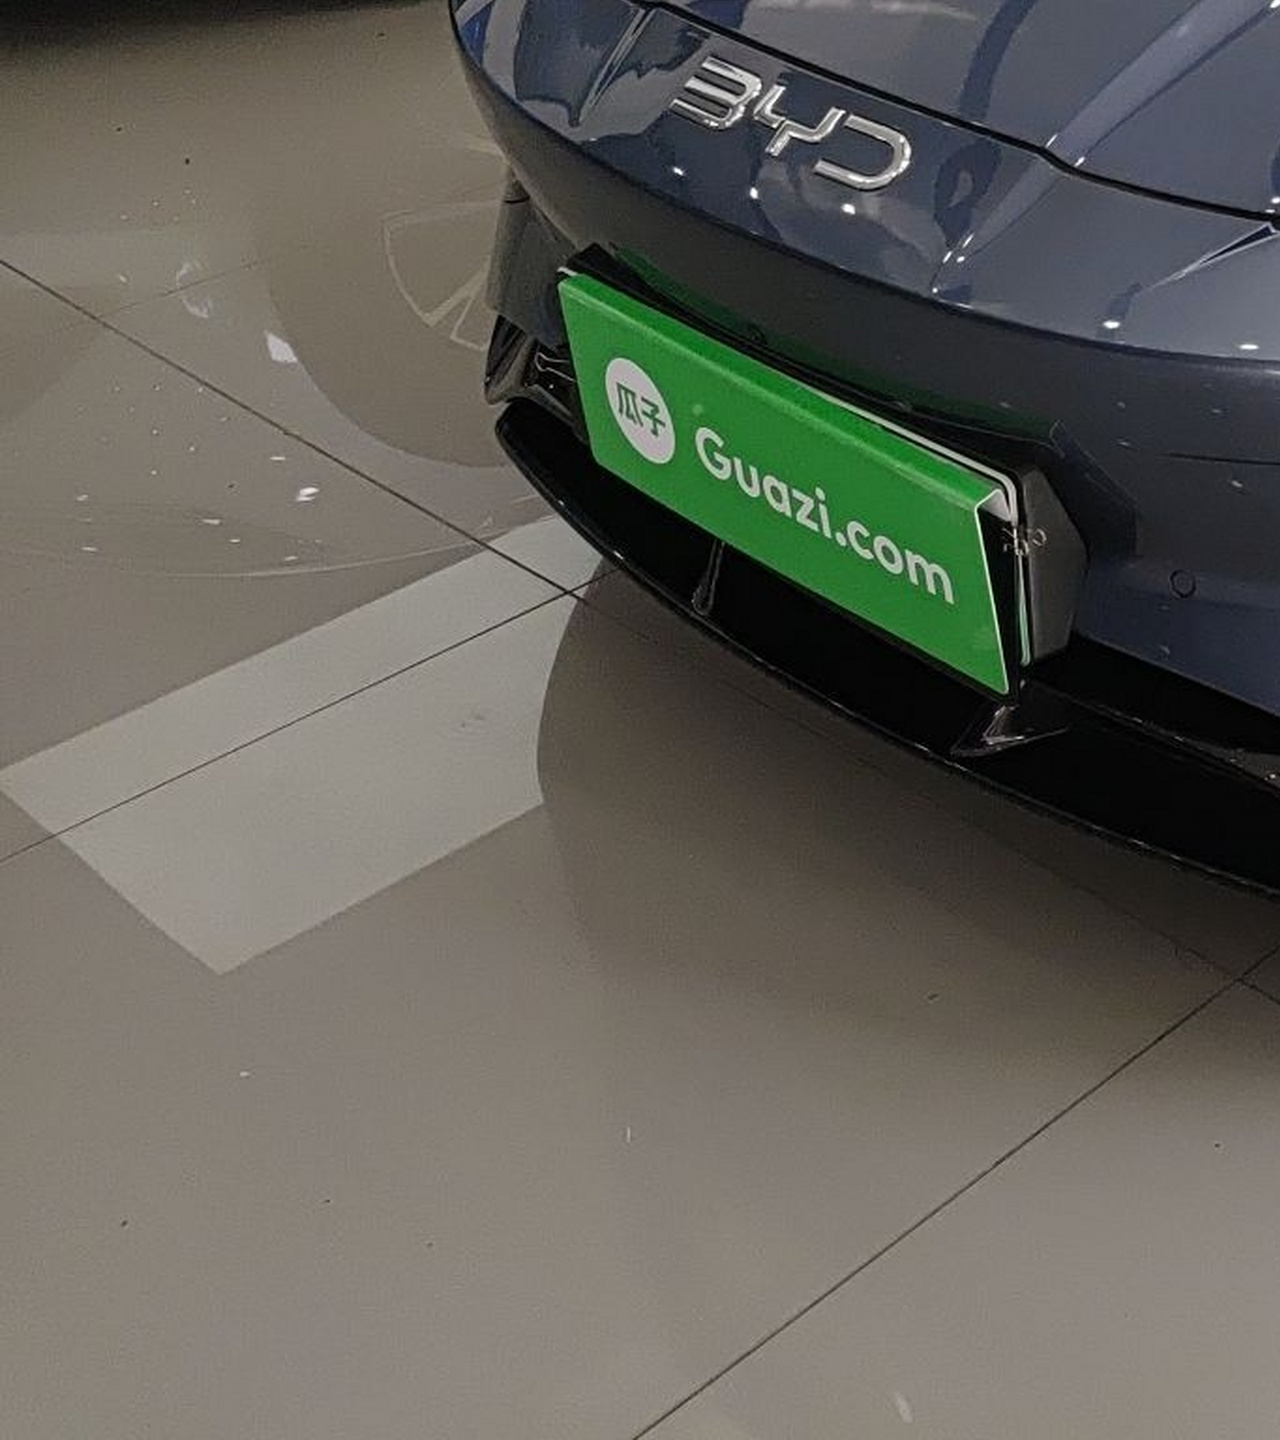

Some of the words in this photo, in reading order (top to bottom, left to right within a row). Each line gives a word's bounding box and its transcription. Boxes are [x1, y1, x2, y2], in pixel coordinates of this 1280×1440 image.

[669, 56, 912, 191] BYD
[615, 381, 667, 439] 瓜子
[695, 426, 955, 606] Guazi.com
